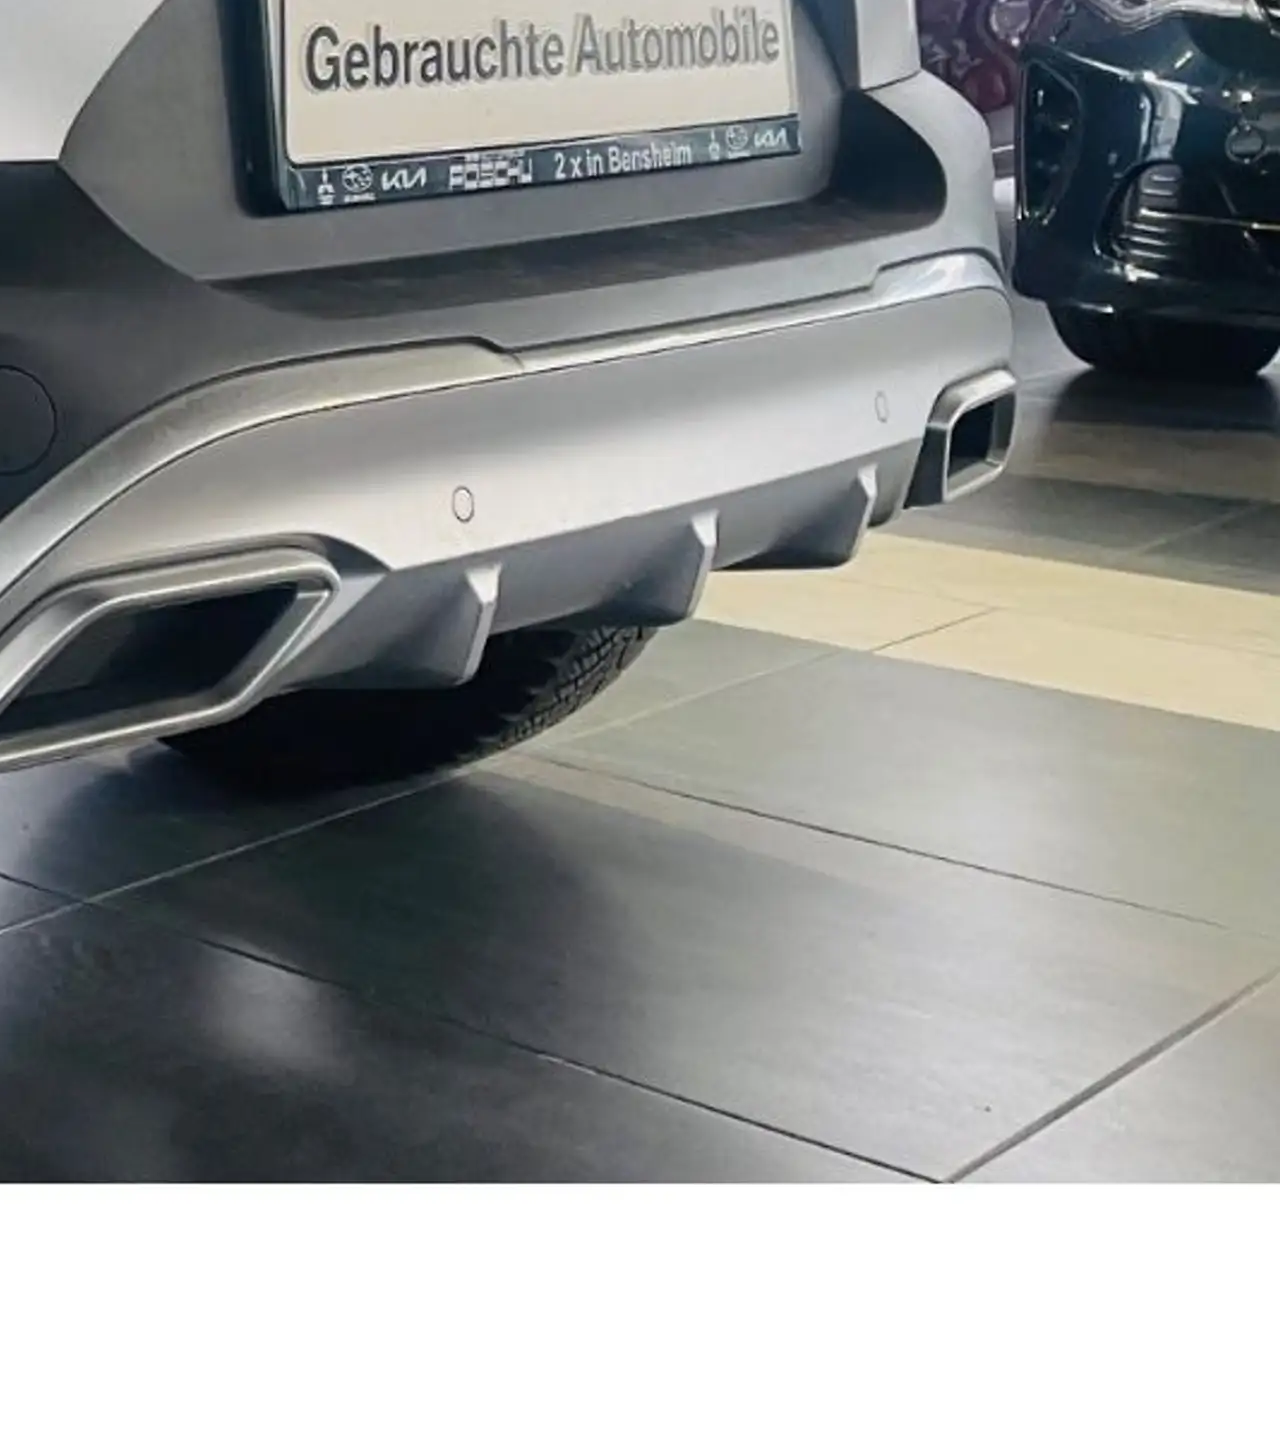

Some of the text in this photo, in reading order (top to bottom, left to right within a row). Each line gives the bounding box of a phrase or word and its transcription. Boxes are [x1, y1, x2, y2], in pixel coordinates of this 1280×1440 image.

[305, 6, 781, 91] Gebrauchte Automobile
[554, 152, 566, 180] 2
[570, 156, 582, 179] x
[586, 148, 605, 177] in
[608, 139, 693, 175] Bensheim
